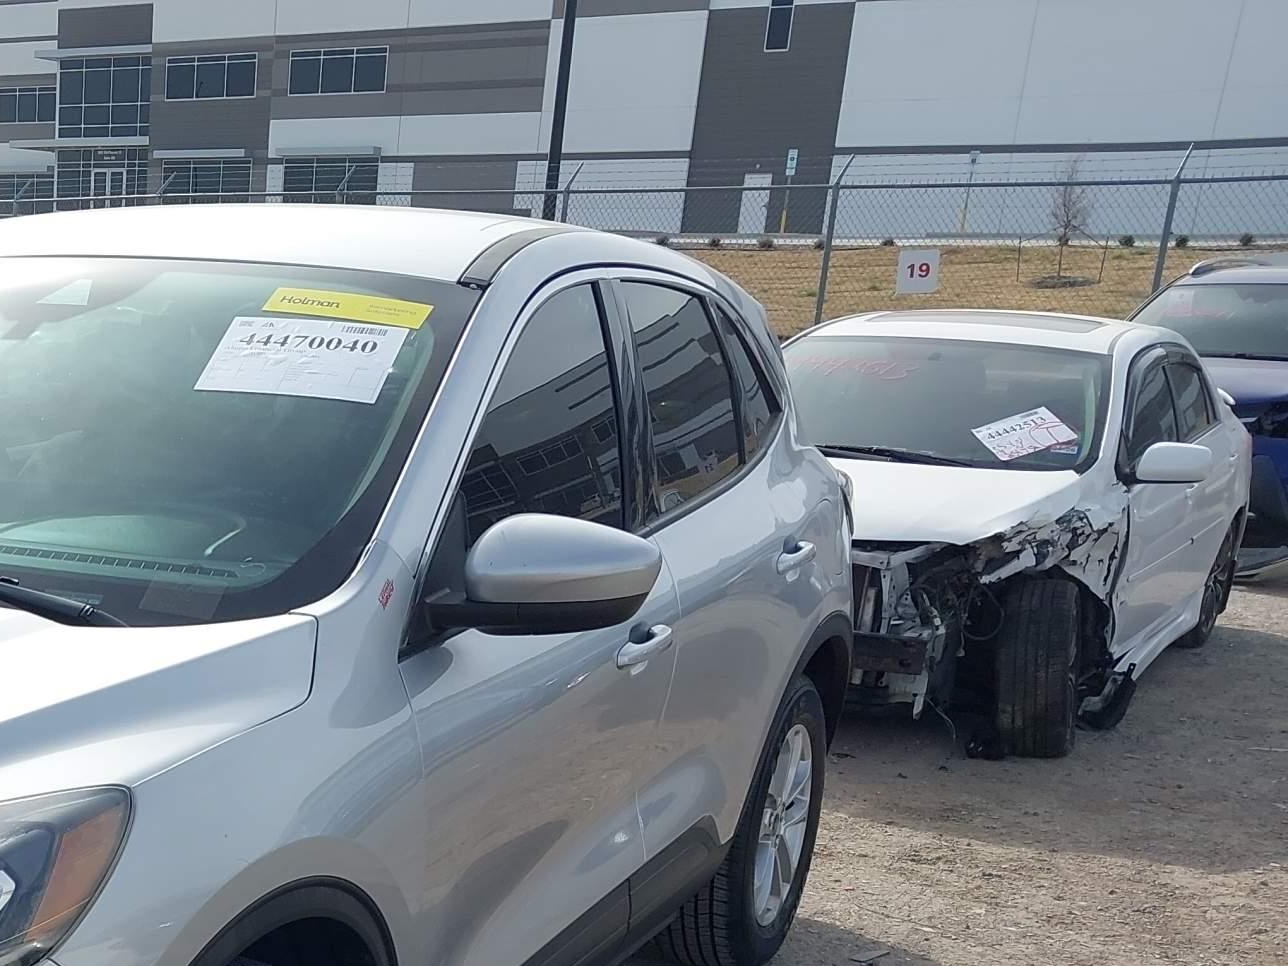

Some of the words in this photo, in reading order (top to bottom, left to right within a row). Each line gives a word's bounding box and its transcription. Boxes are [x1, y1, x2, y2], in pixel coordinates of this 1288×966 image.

[906, 262, 931, 279] 19
[280, 295, 341, 310] Holman
[239, 332, 379, 354] 44470040
